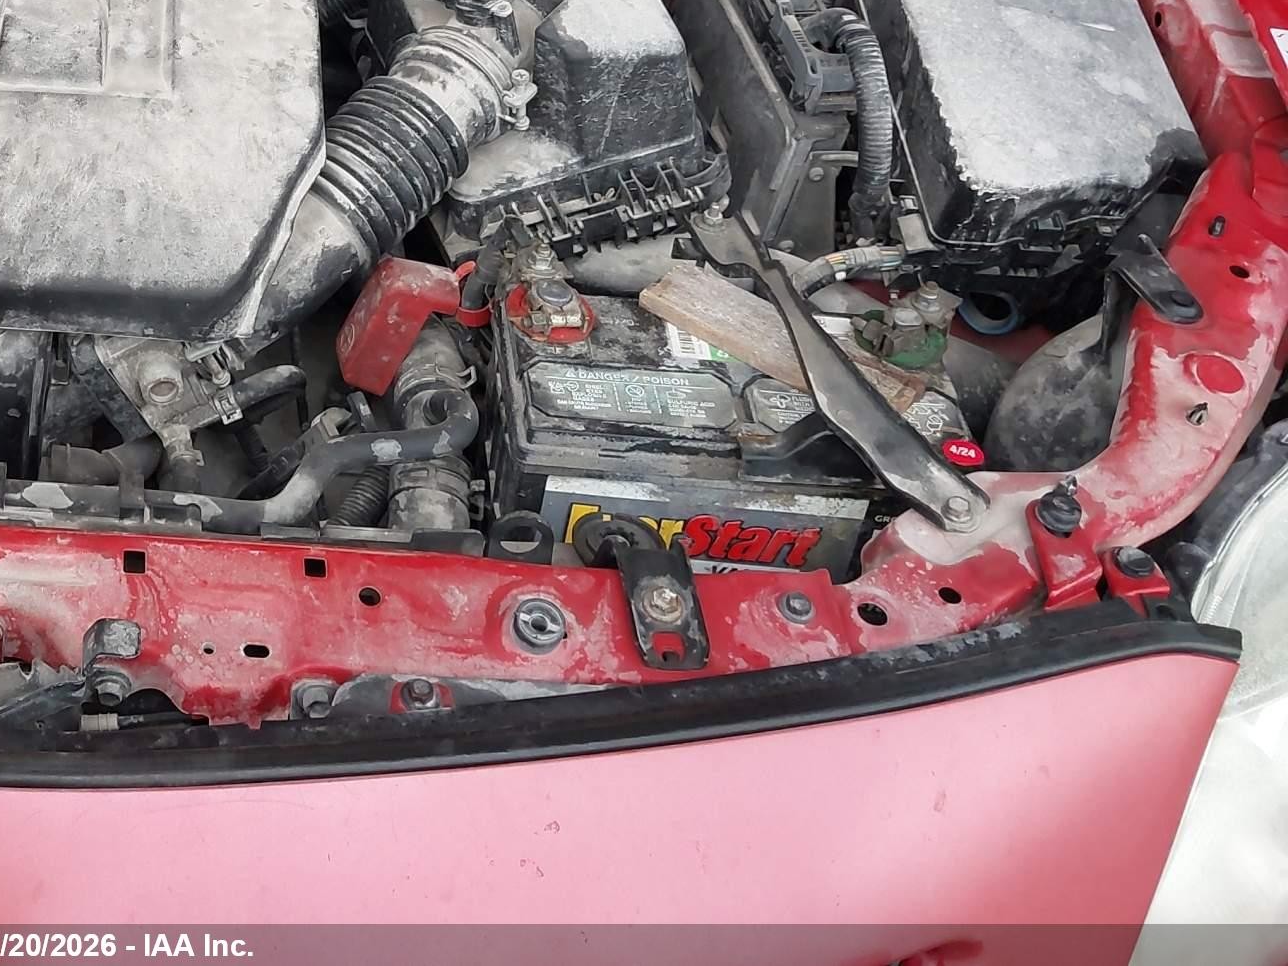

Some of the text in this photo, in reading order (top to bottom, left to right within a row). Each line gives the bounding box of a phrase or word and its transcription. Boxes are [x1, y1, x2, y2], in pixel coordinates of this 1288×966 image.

[578, 370, 630, 383] DANGER
[642, 376, 689, 386] POISON
[948, 444, 977, 458] 4/24
